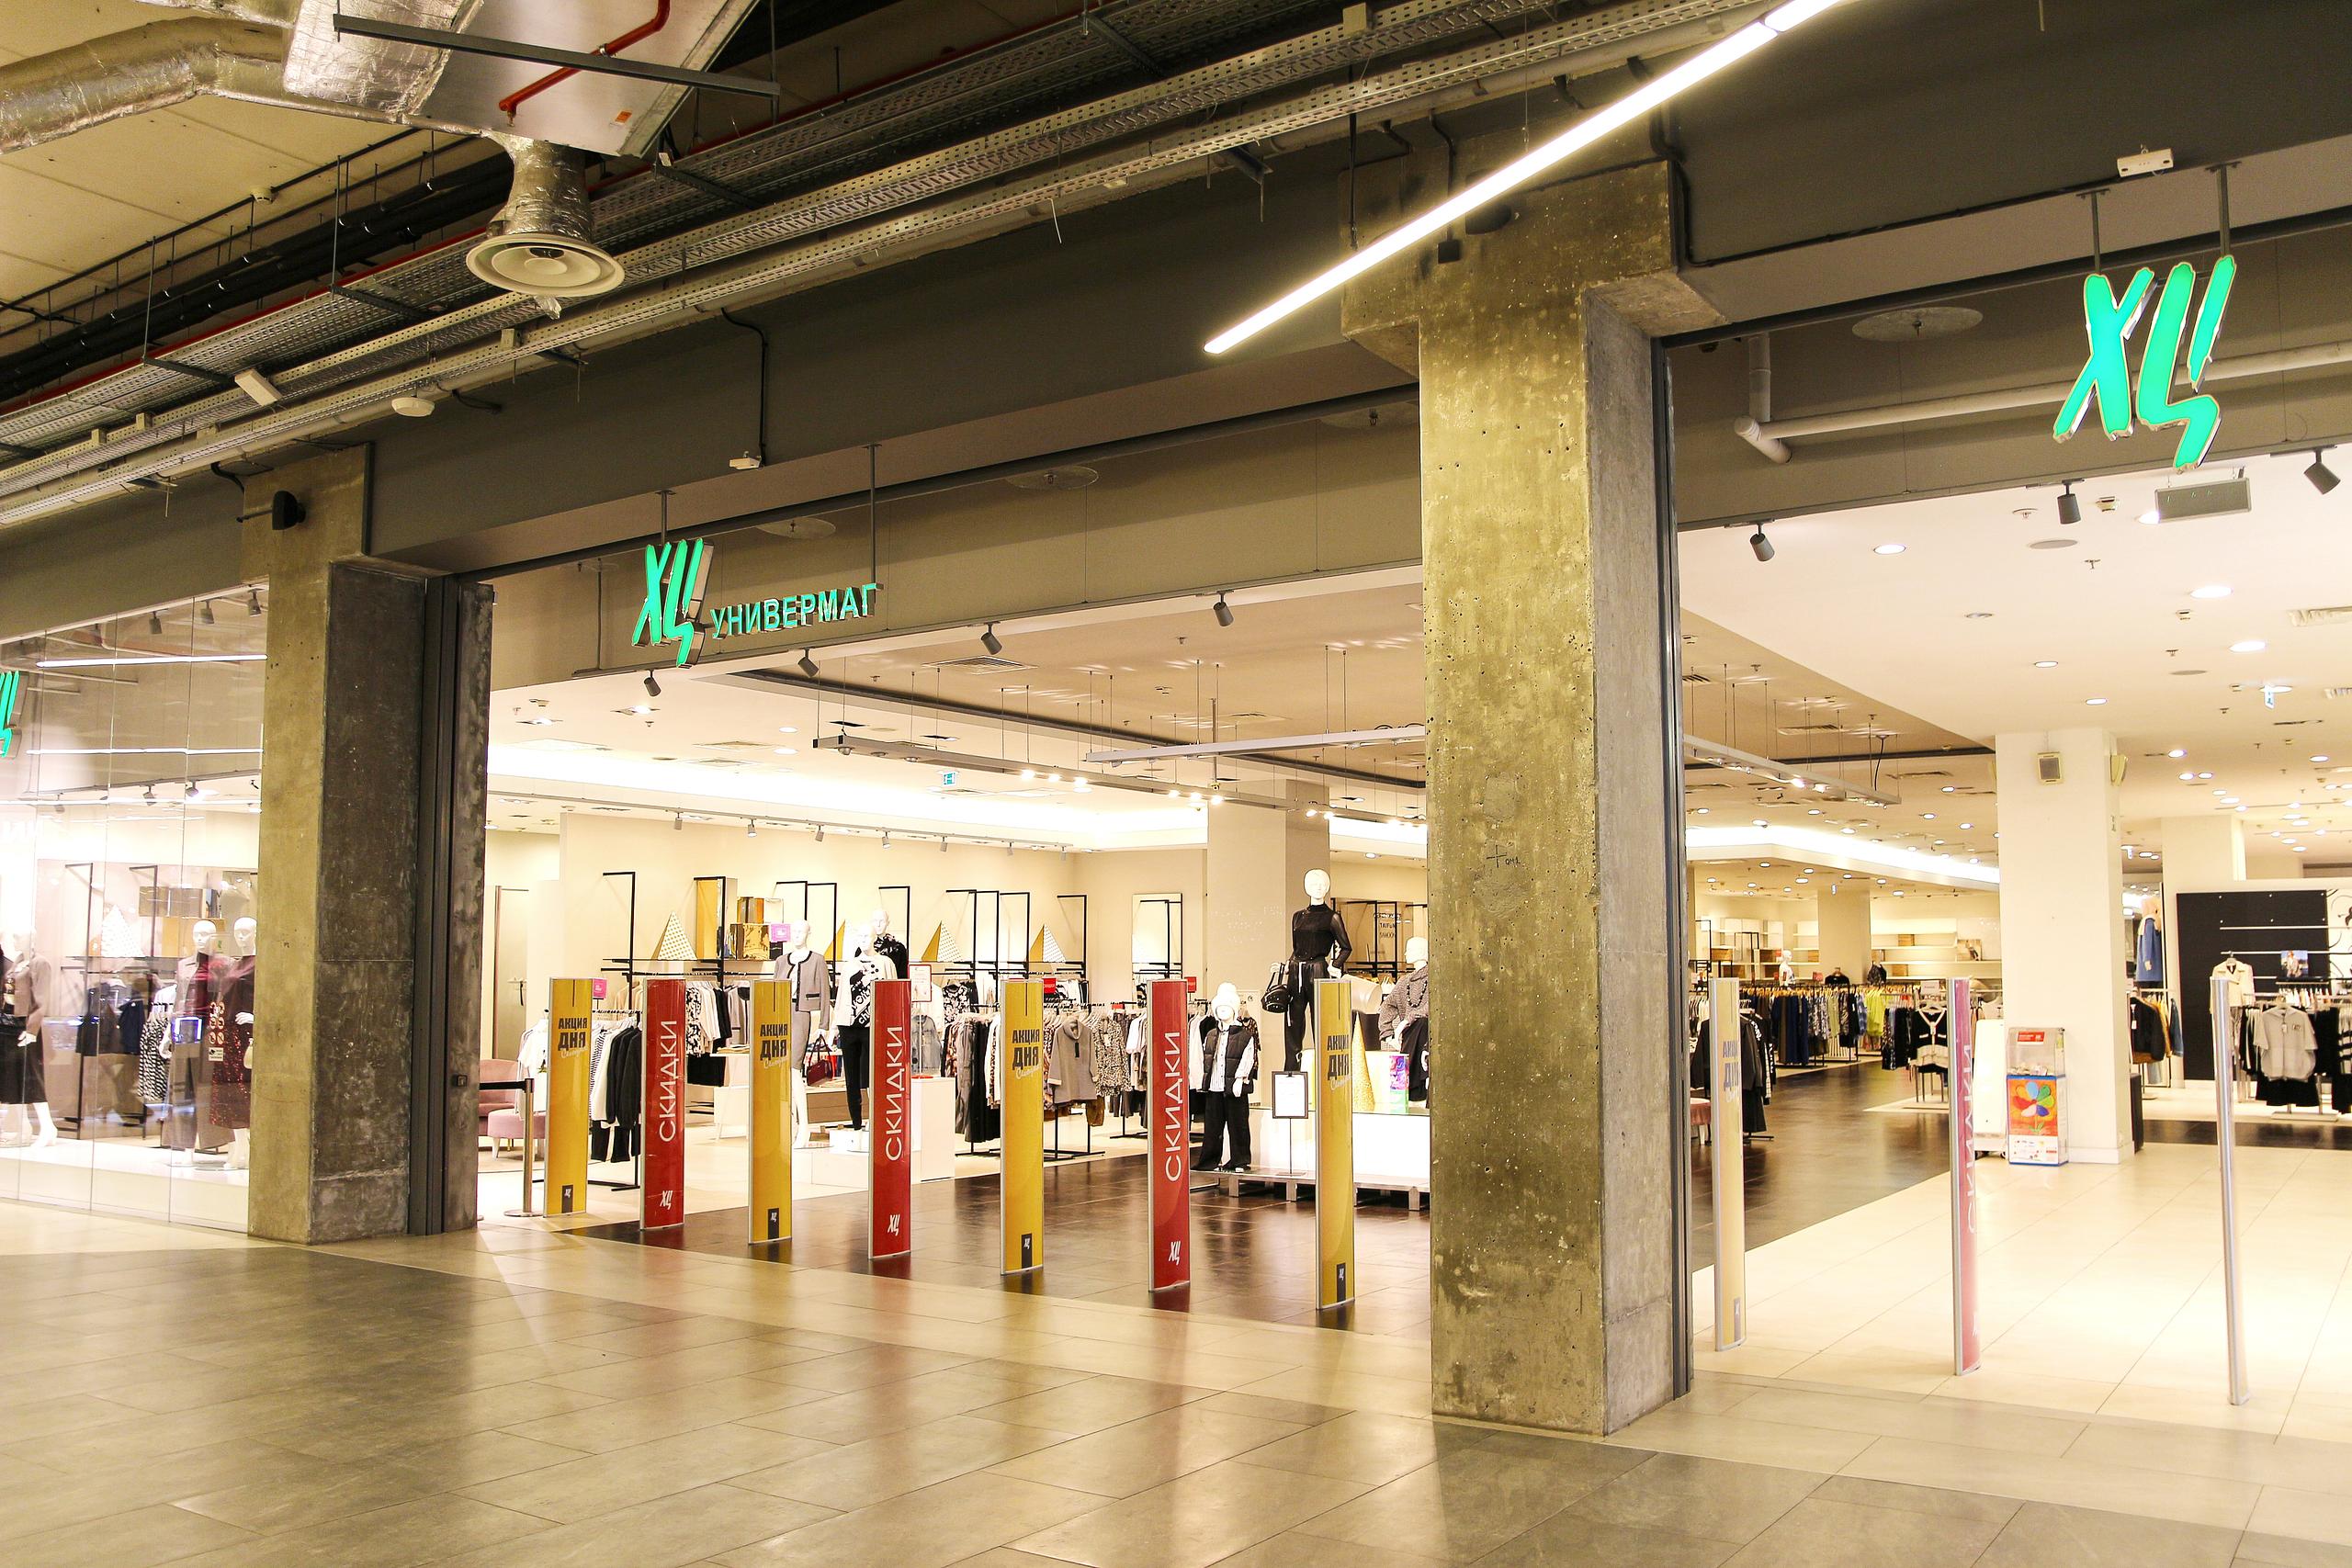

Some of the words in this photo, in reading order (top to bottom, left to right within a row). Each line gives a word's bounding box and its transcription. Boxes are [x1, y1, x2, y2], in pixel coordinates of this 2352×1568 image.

[710, 582, 877, 639] УНИВЕРМАГ
[558, 1017, 588, 1031] АКЦИЯ
[760, 1023, 788, 1038] АКЦИЯ
[558, 1032, 586, 1052] ДНЯ
[1012, 1029, 1040, 1045] АКЦИЯ
[760, 1039, 787, 1061] ДНЯ
[1012, 1046, 1039, 1071] ДНЯ
[659, 1021, 679, 1142] СКИДКИ
[885, 1026, 905, 1161] СКИДКИ
[1164, 1031, 1183, 1182] СКИДКИ
